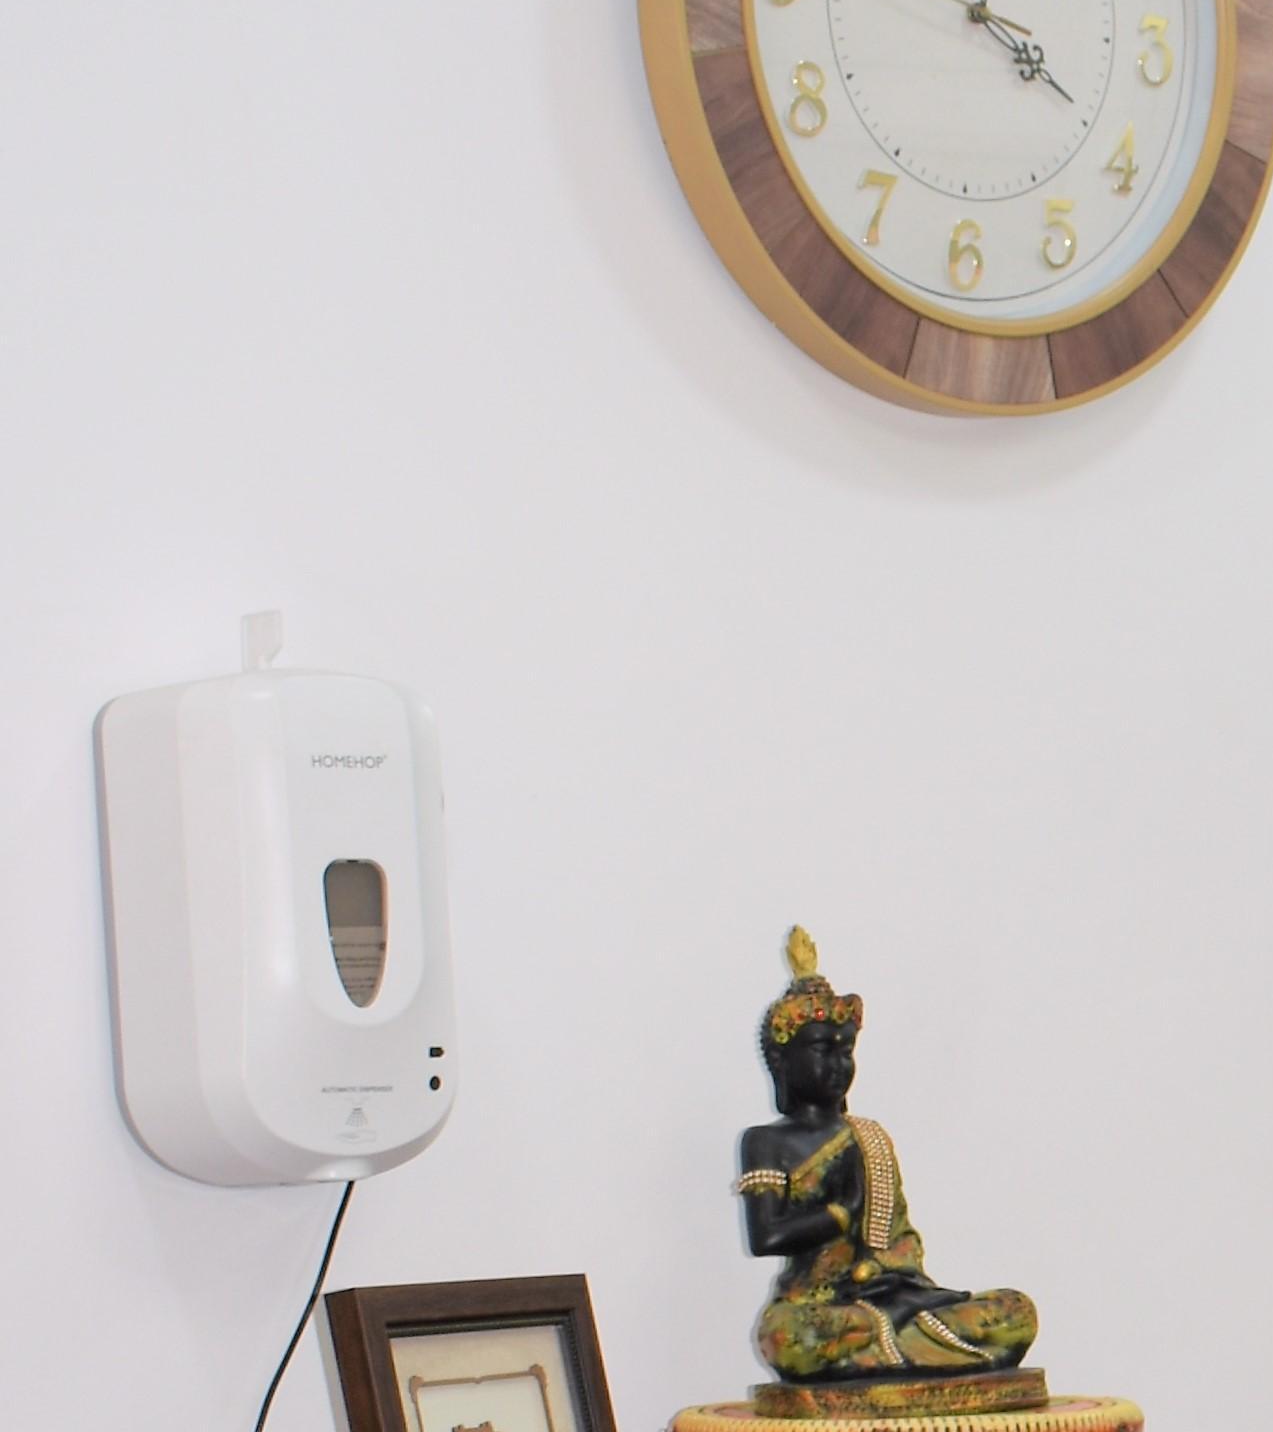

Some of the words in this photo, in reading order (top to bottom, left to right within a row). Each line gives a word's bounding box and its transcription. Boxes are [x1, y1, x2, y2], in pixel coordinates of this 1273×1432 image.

[1138, 15, 1174, 86] 3
[787, 61, 827, 137] 8
[1105, 122, 1139, 194] 4
[857, 170, 898, 245] 7
[1041, 198, 1077, 269] 5
[948, 220, 985, 293] 6
[311, 754, 384, 769] HOMEHOP
